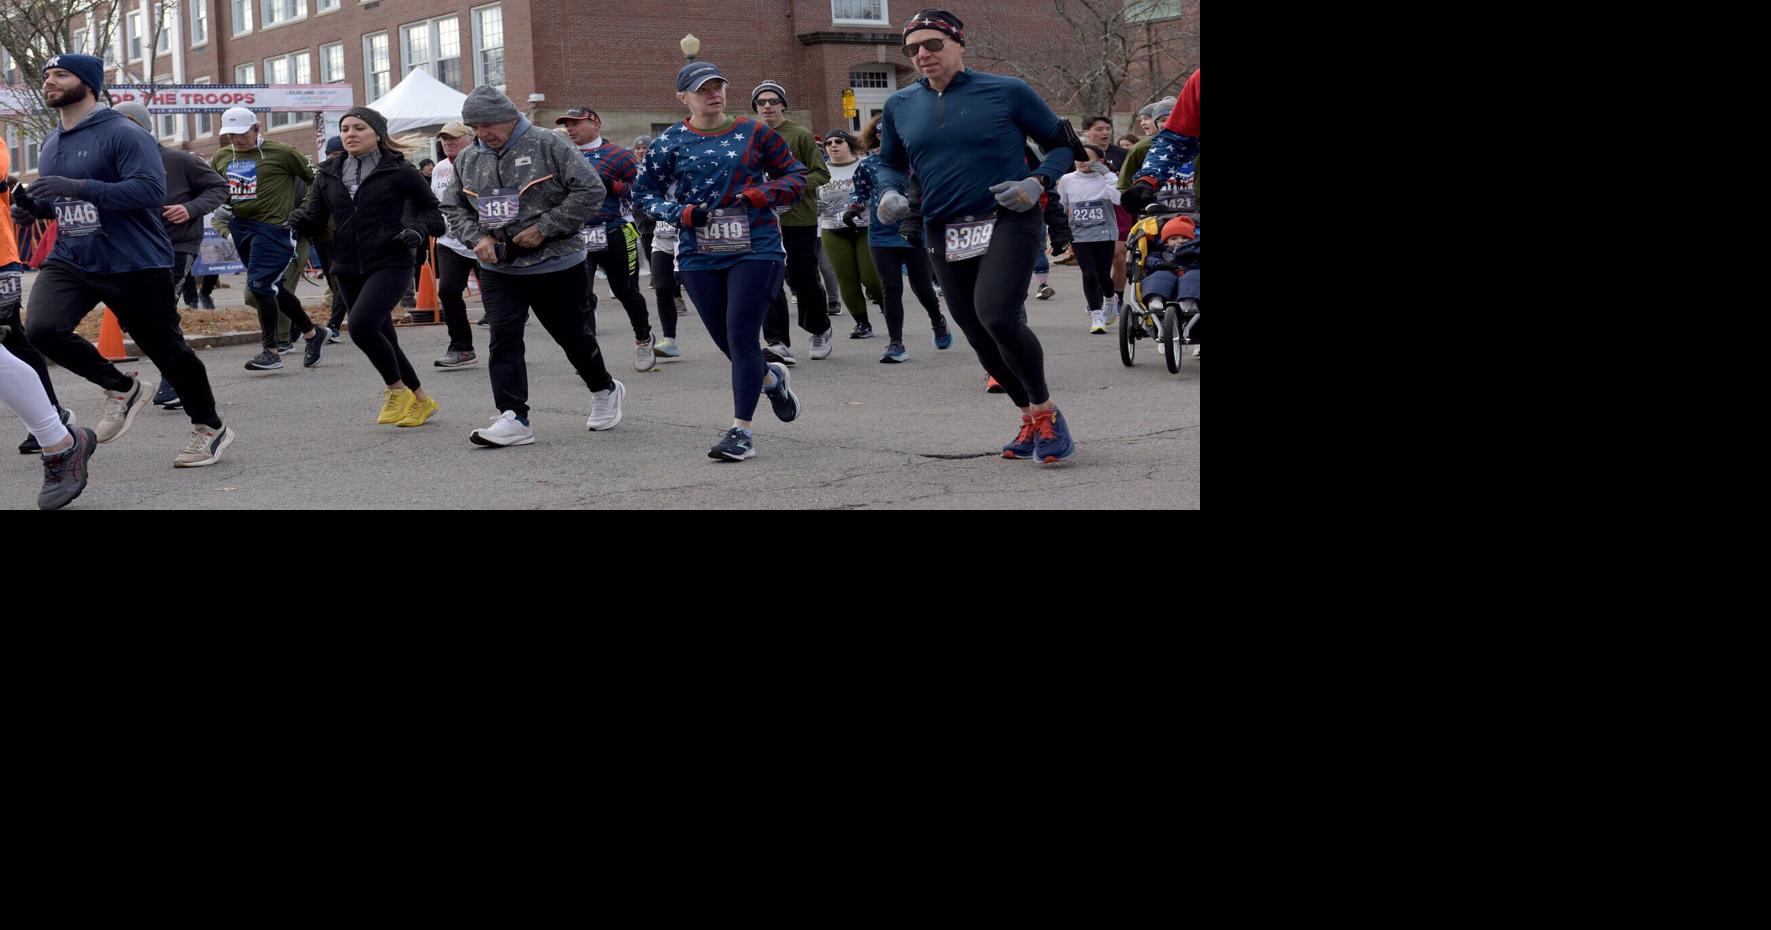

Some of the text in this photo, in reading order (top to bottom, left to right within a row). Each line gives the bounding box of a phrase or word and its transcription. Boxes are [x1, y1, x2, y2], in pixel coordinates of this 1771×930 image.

[140, 92, 177, 105] THE
[181, 92, 256, 105] TROOPS
[55, 203, 97, 226] 2446
[485, 200, 509, 217] 131
[1073, 207, 1104, 221] 2243
[703, 221, 743, 240] 1419
[946, 223, 993, 250] 3369
